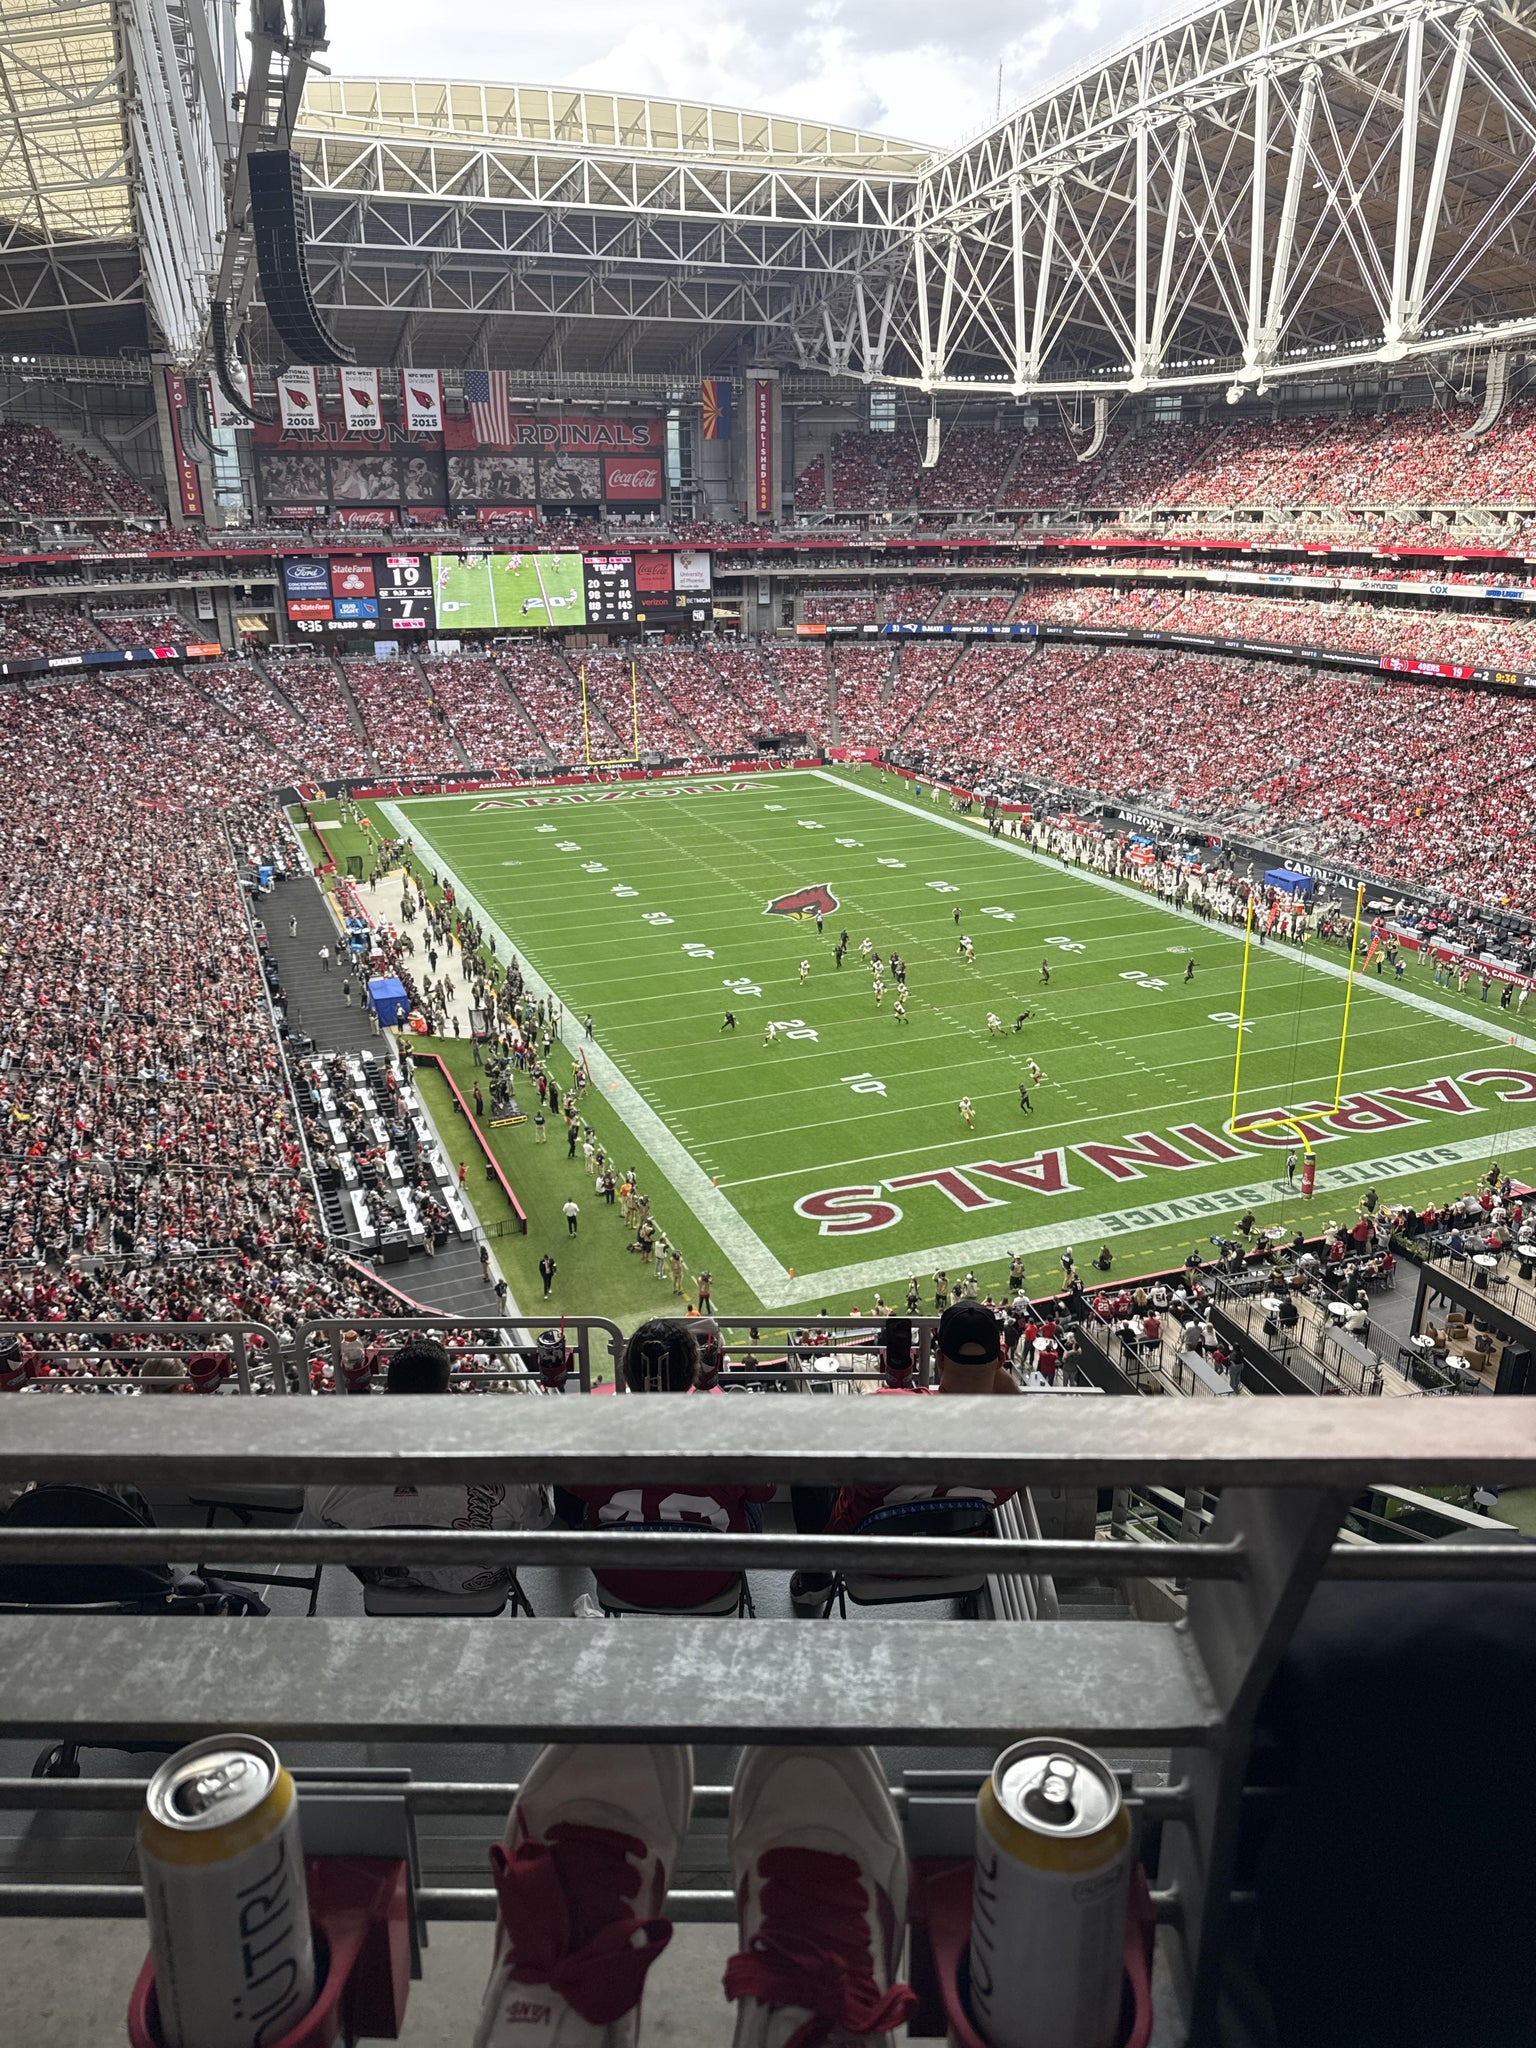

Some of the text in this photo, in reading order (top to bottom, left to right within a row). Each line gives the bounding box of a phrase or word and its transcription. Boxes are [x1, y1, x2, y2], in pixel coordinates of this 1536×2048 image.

[280, 421, 436, 442] ARIZONA
[473, 424, 650, 445] RDINALS
[184, 471, 197, 512] CLUB
[294, 566, 318, 577] Ford
[393, 568, 419, 586] 19
[588, 580, 600, 588] 20
[620, 579, 628, 588] 31
[1430, 586, 1448, 594] COX
[588, 591, 600, 599] 98
[400, 600, 414, 617] 7
[618, 601, 632, 609] 145
[592, 612, 599, 621] 9
[622, 612, 629, 620] 8
[297, 620, 323, 632] 9:36
[124, 651, 133, 660] 4
[1418, 663, 1440, 672] 49ERS
[1453, 667, 1463, 677] 19
[1482, 672, 1489, 680] 2
[1495, 673, 1517, 684] 9:36
[470, 781, 781, 812] ARIZONA
[641, 911, 675, 925] 50
[723, 978, 762, 998] 30
[772, 1019, 819, 1042] 20
[840, 1072, 888, 1097] 10
[793, 1068, 1536, 1236] CARDINALS
[1327, 1148, 1464, 1184] SALUTE
[1102, 1186, 1268, 1231] SERVICE
[1098, 1302, 1109, 1311] 22
